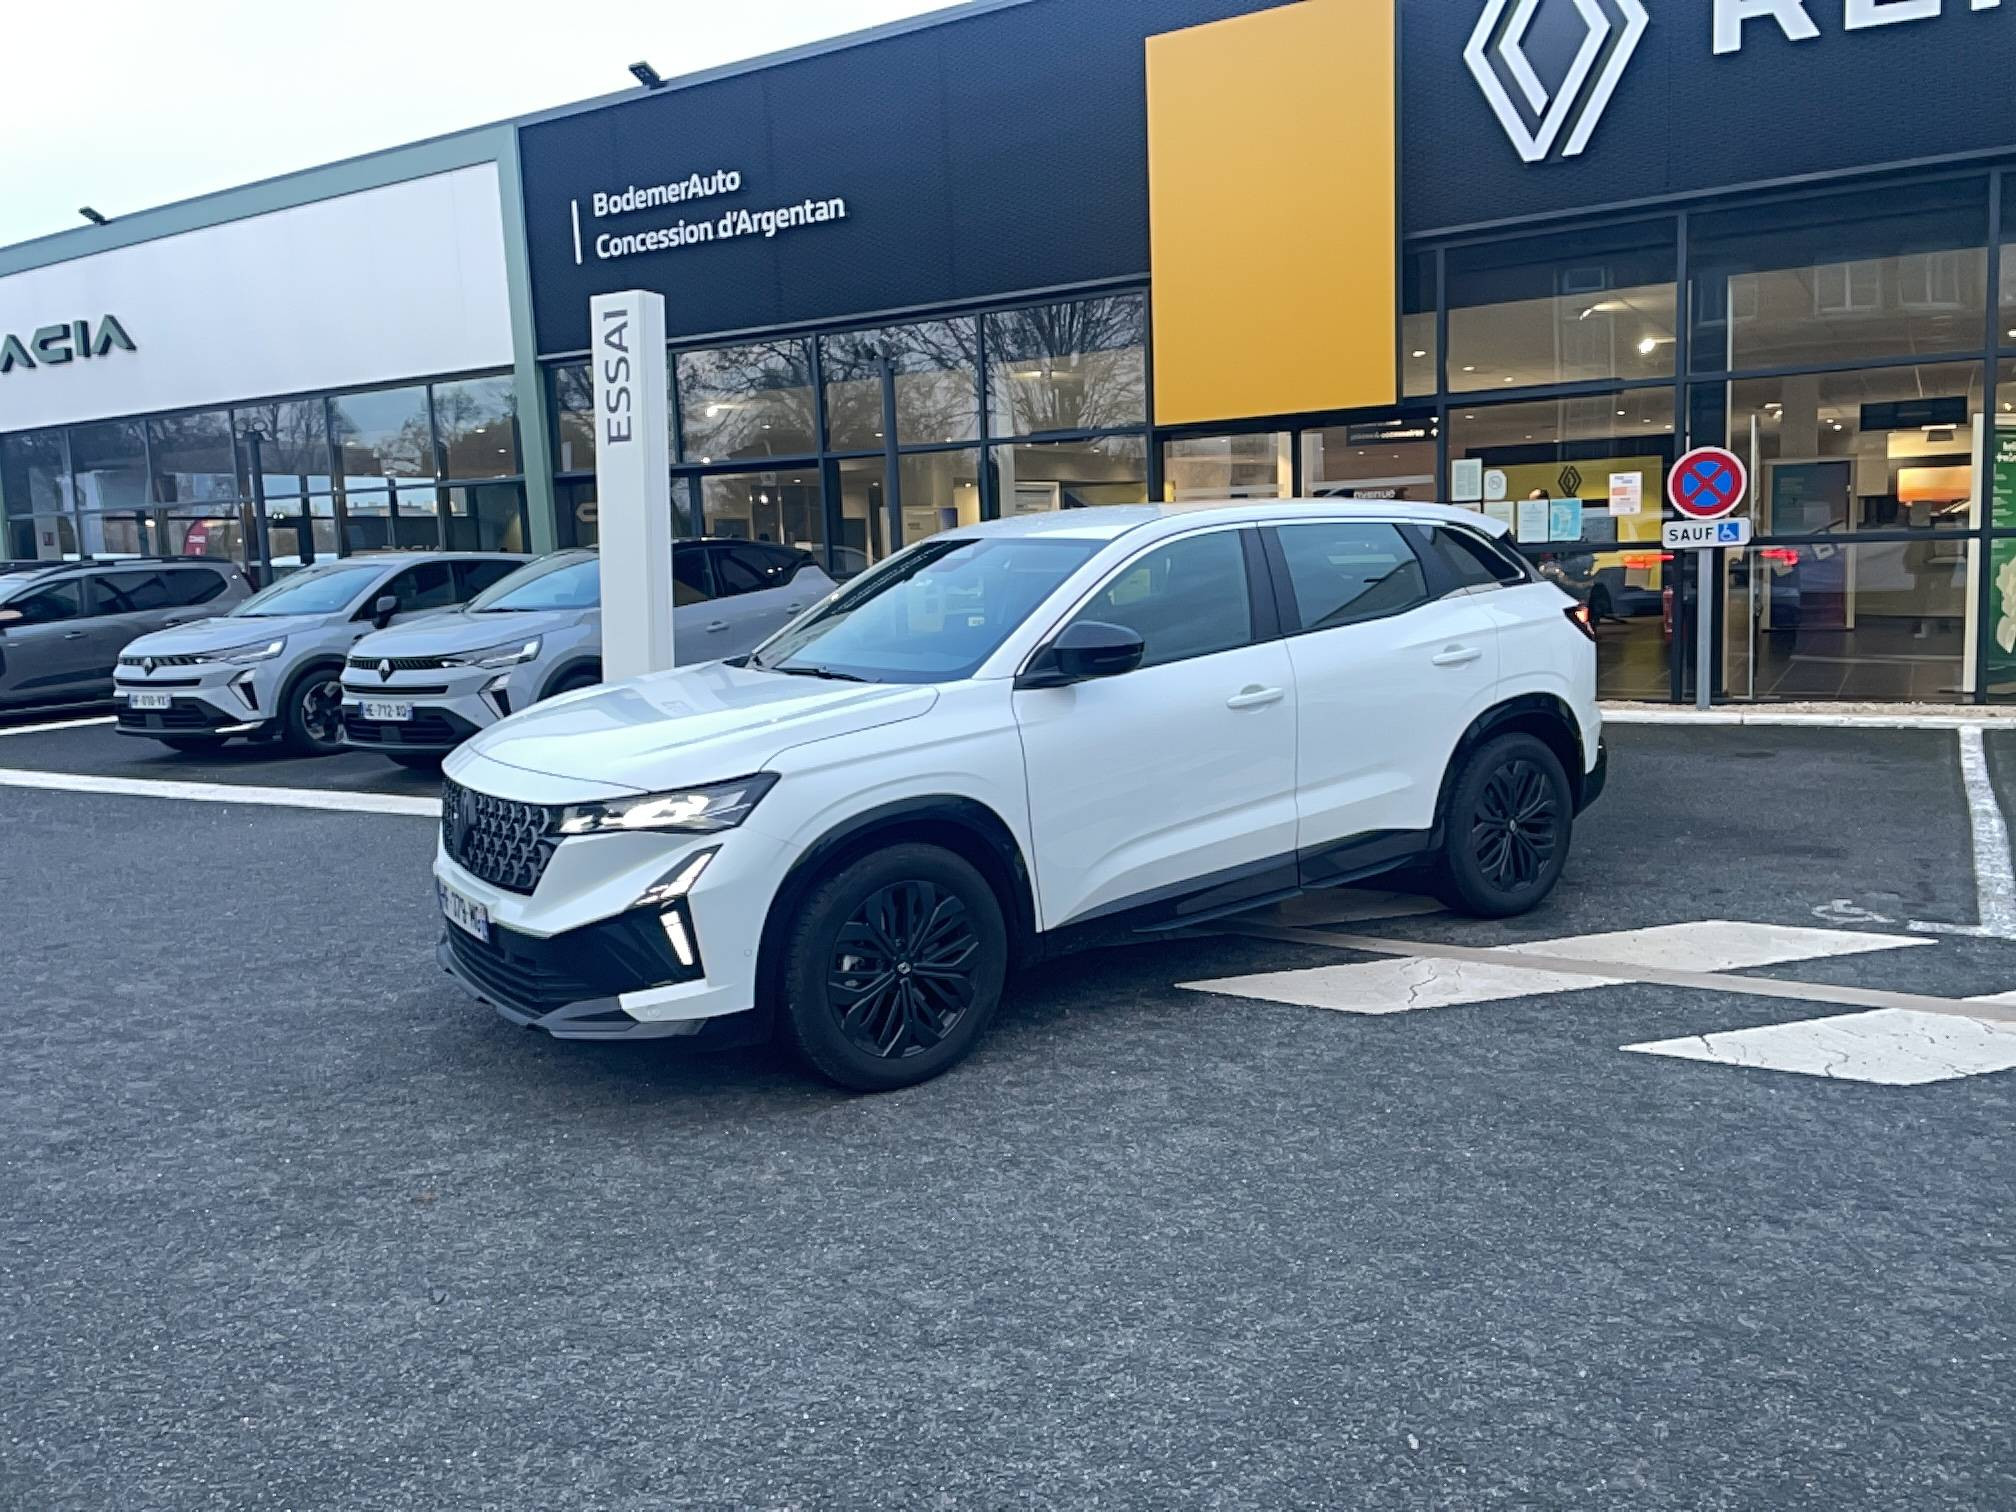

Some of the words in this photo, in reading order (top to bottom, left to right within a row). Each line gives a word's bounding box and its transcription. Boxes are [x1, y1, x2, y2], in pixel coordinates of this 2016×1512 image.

[593, 170, 742, 217] BodemerAuto
[596, 219, 714, 259] Concession
[717, 197, 846, 237] d'Argentan
[603, 309, 632, 446] ESSAI
[1669, 527, 1714, 541] SAUF
